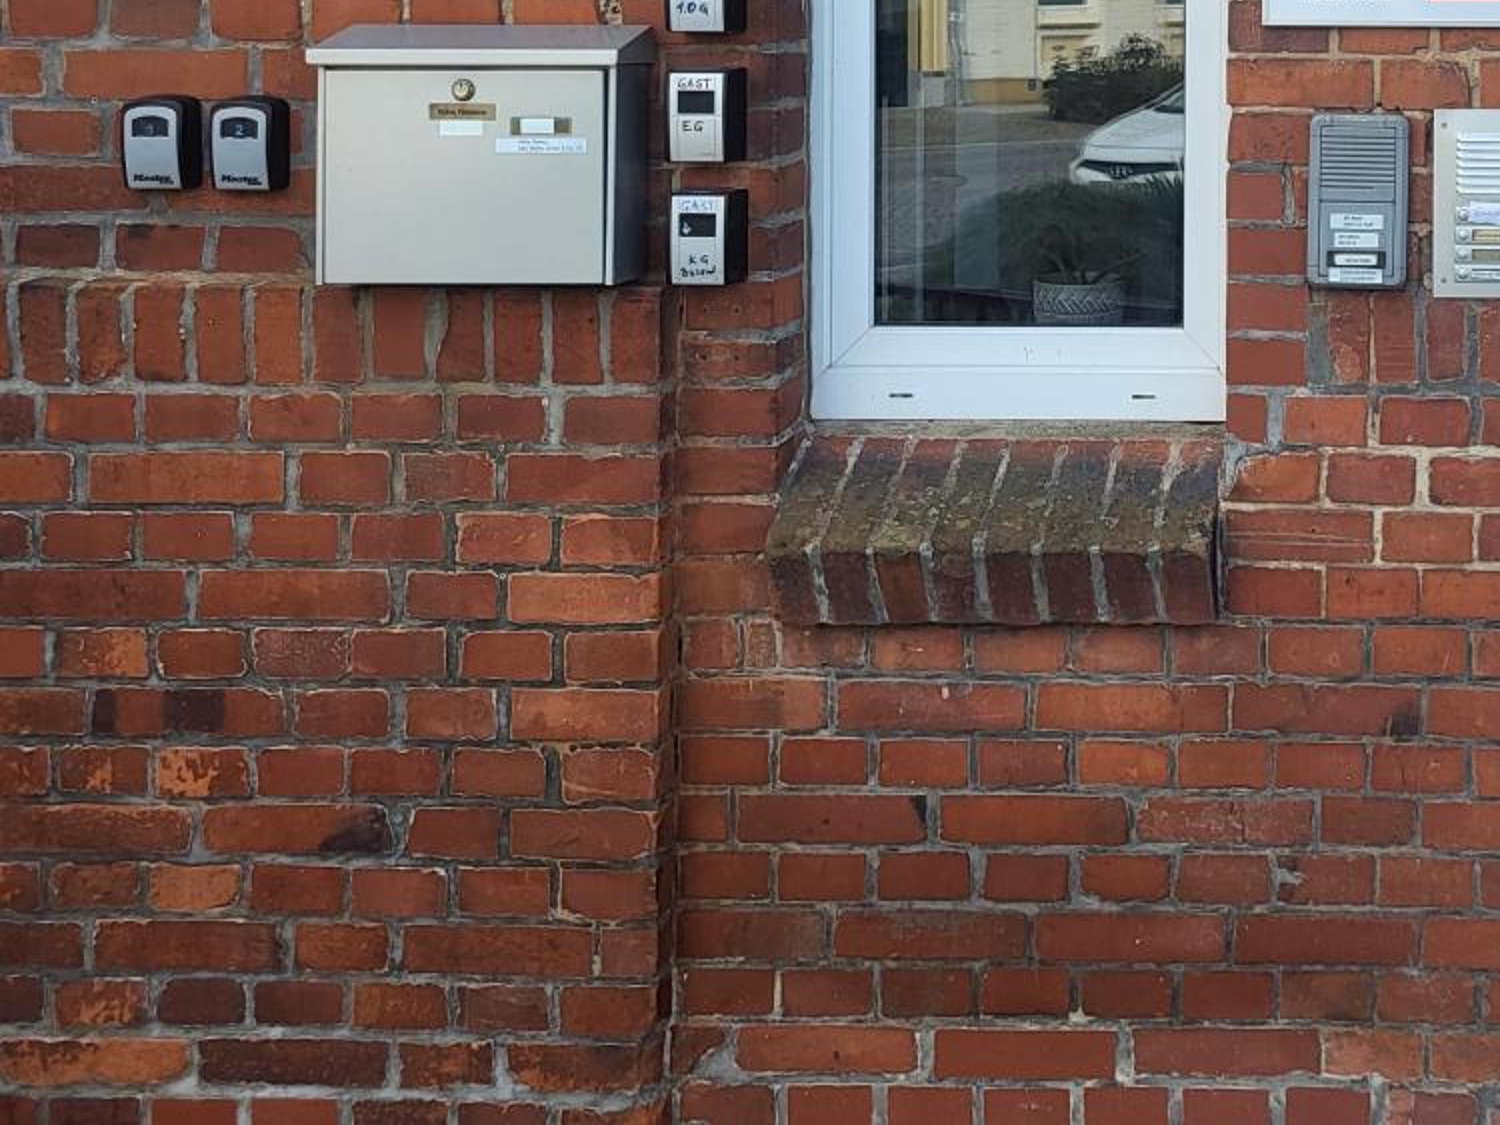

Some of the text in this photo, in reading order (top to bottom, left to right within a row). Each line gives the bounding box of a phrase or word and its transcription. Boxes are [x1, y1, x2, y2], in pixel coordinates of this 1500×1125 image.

[677, 78, 712, 89] GAST
[234, 123, 243, 136] 2
[682, 120, 703, 132] EG
[221, 174, 258, 183] Master
